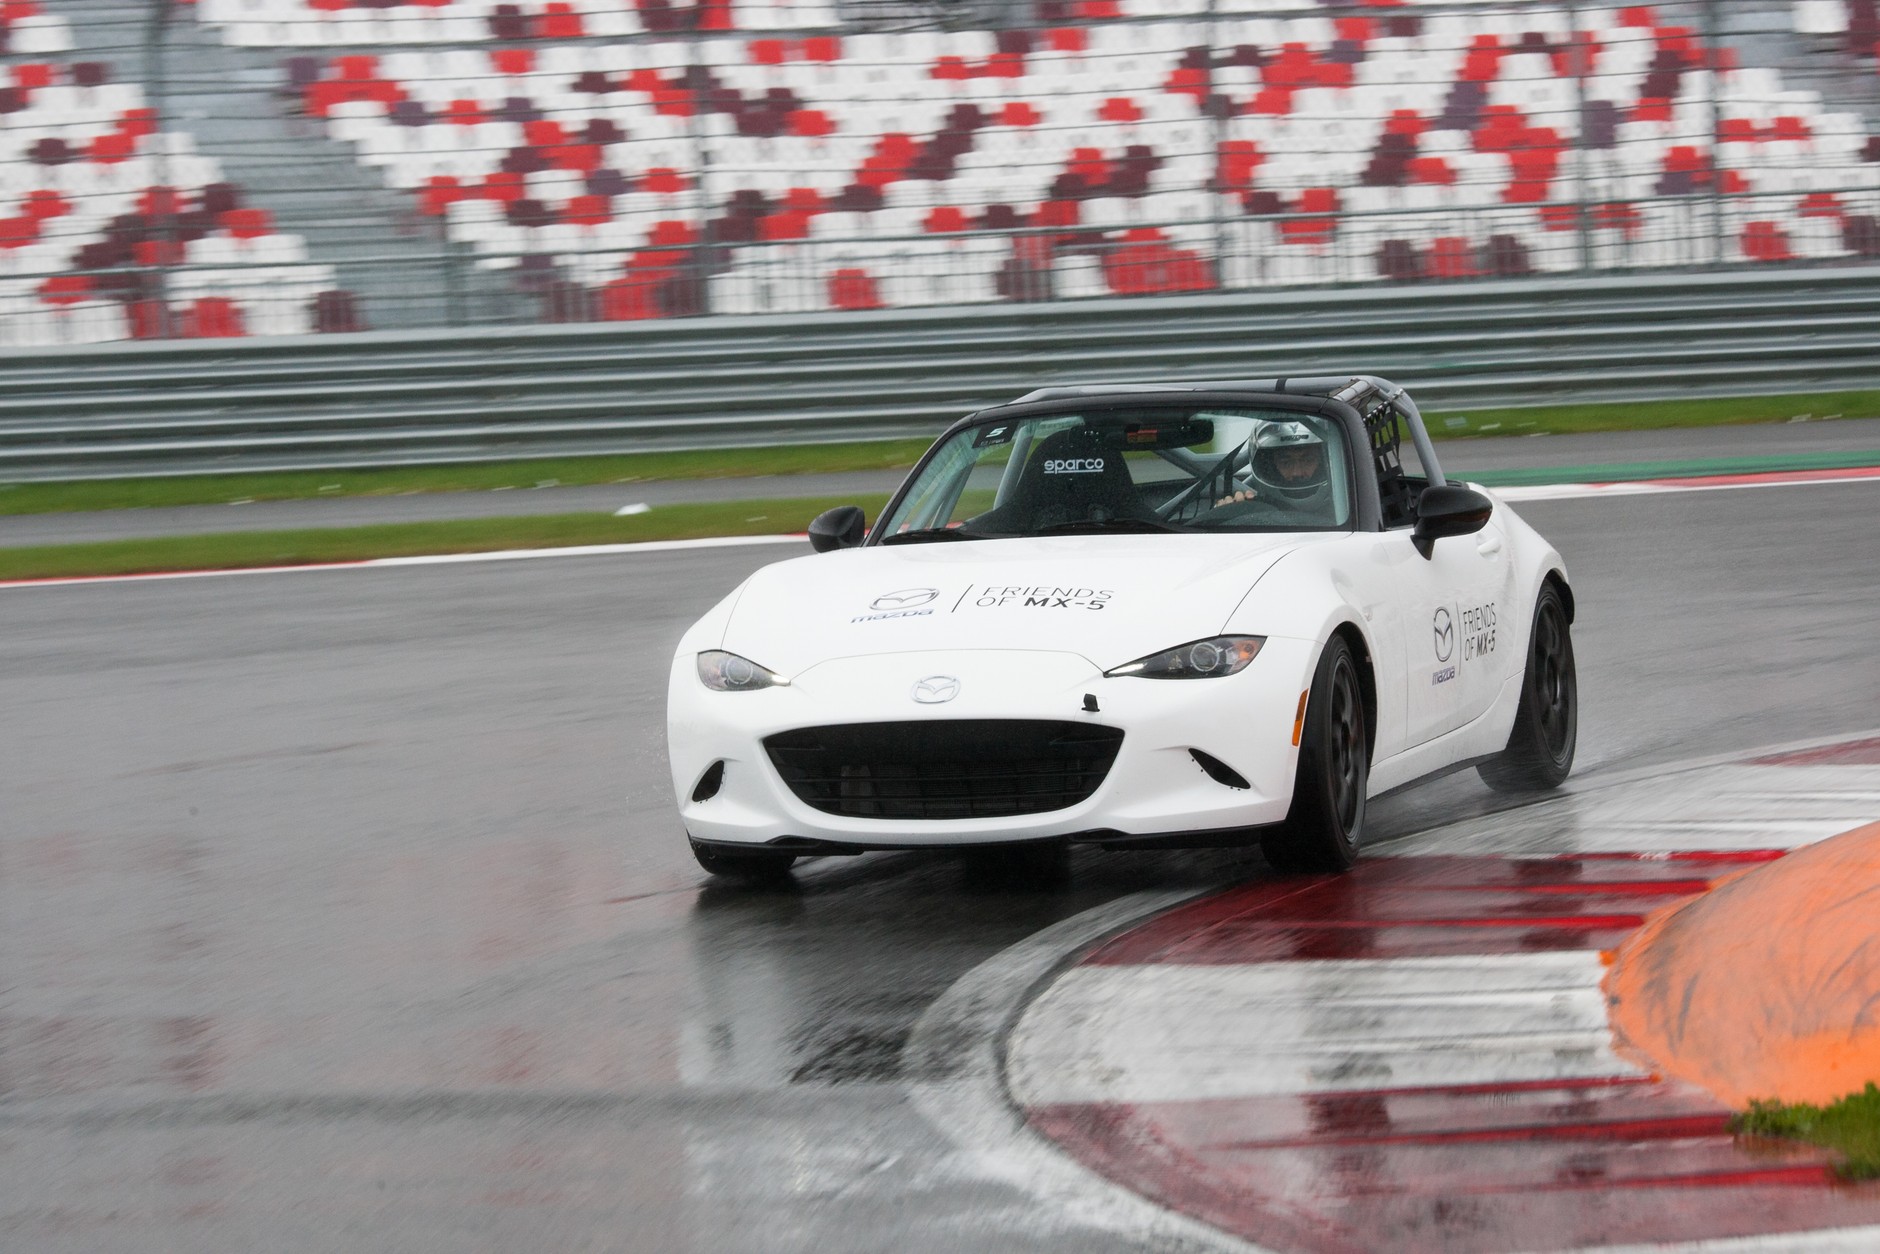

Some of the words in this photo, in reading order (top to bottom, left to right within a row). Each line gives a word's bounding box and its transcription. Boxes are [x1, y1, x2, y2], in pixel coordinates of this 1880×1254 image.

[1043, 458, 1104, 475] sparco
[982, 586, 1115, 600] FRIENDS
[976, 596, 1017, 607] OF
[1023, 597, 1107, 610] MX-5
[1463, 602, 1497, 635] FRIENDS
[1464, 636, 1475, 661] OF
[1476, 629, 1496, 657] MX-5
